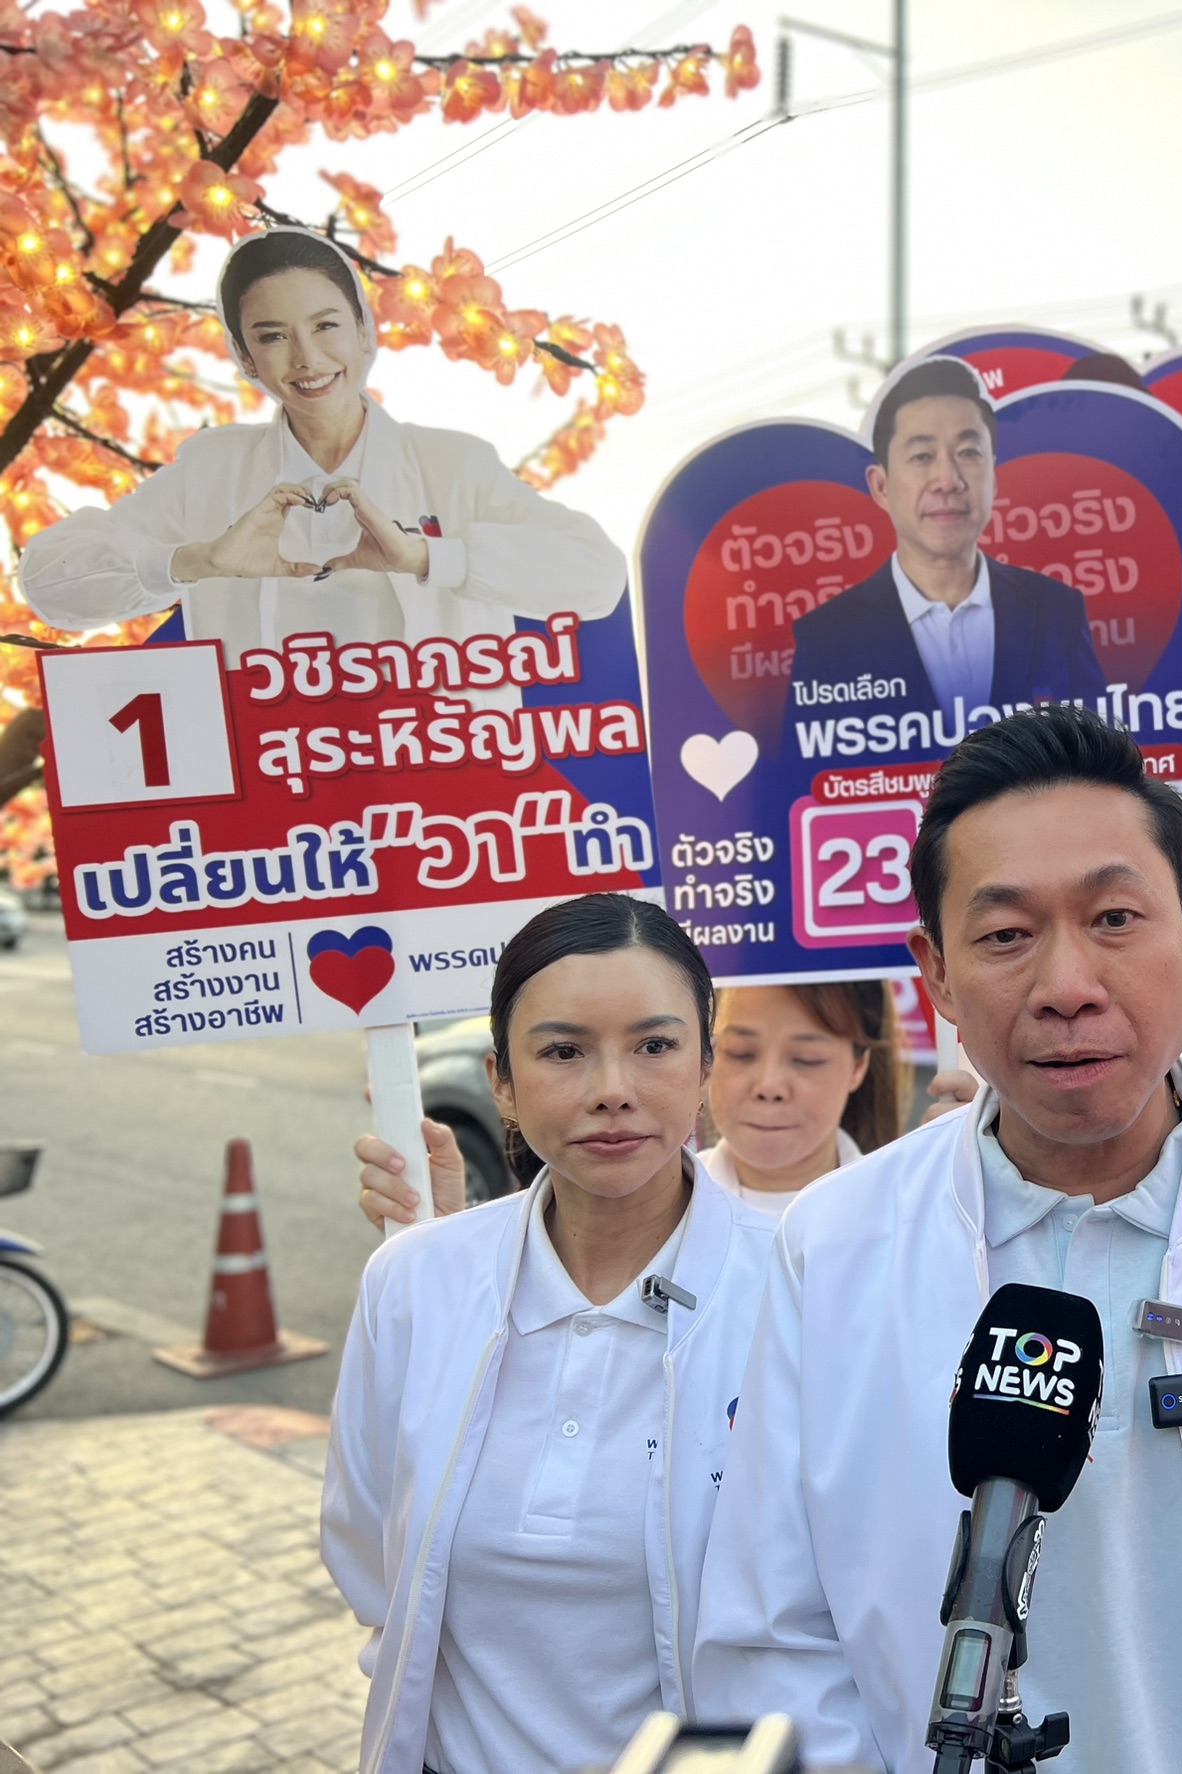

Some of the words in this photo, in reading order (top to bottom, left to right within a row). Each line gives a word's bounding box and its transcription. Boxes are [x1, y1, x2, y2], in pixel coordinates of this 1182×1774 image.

[721, 517, 874, 572] ตัวจริง
[245, 616, 576, 699] วชิราภรณ์
[793, 673, 907, 706] โปรดเลือก
[108, 693, 170, 787] 1
[258, 701, 640, 793] สุระหิรัญพล
[671, 832, 775, 868] ตัวจริง
[818, 834, 912, 907] 23
[674, 874, 775, 911] ทำจริง
[166, 939, 277, 968] สร้างคน
[153, 971, 280, 1002] สร้างงาน
[134, 1000, 284, 1037] สร้างอาชีพ
[989, 1327, 1081, 1372] TOP
[974, 1363, 1075, 1406] NEWS
